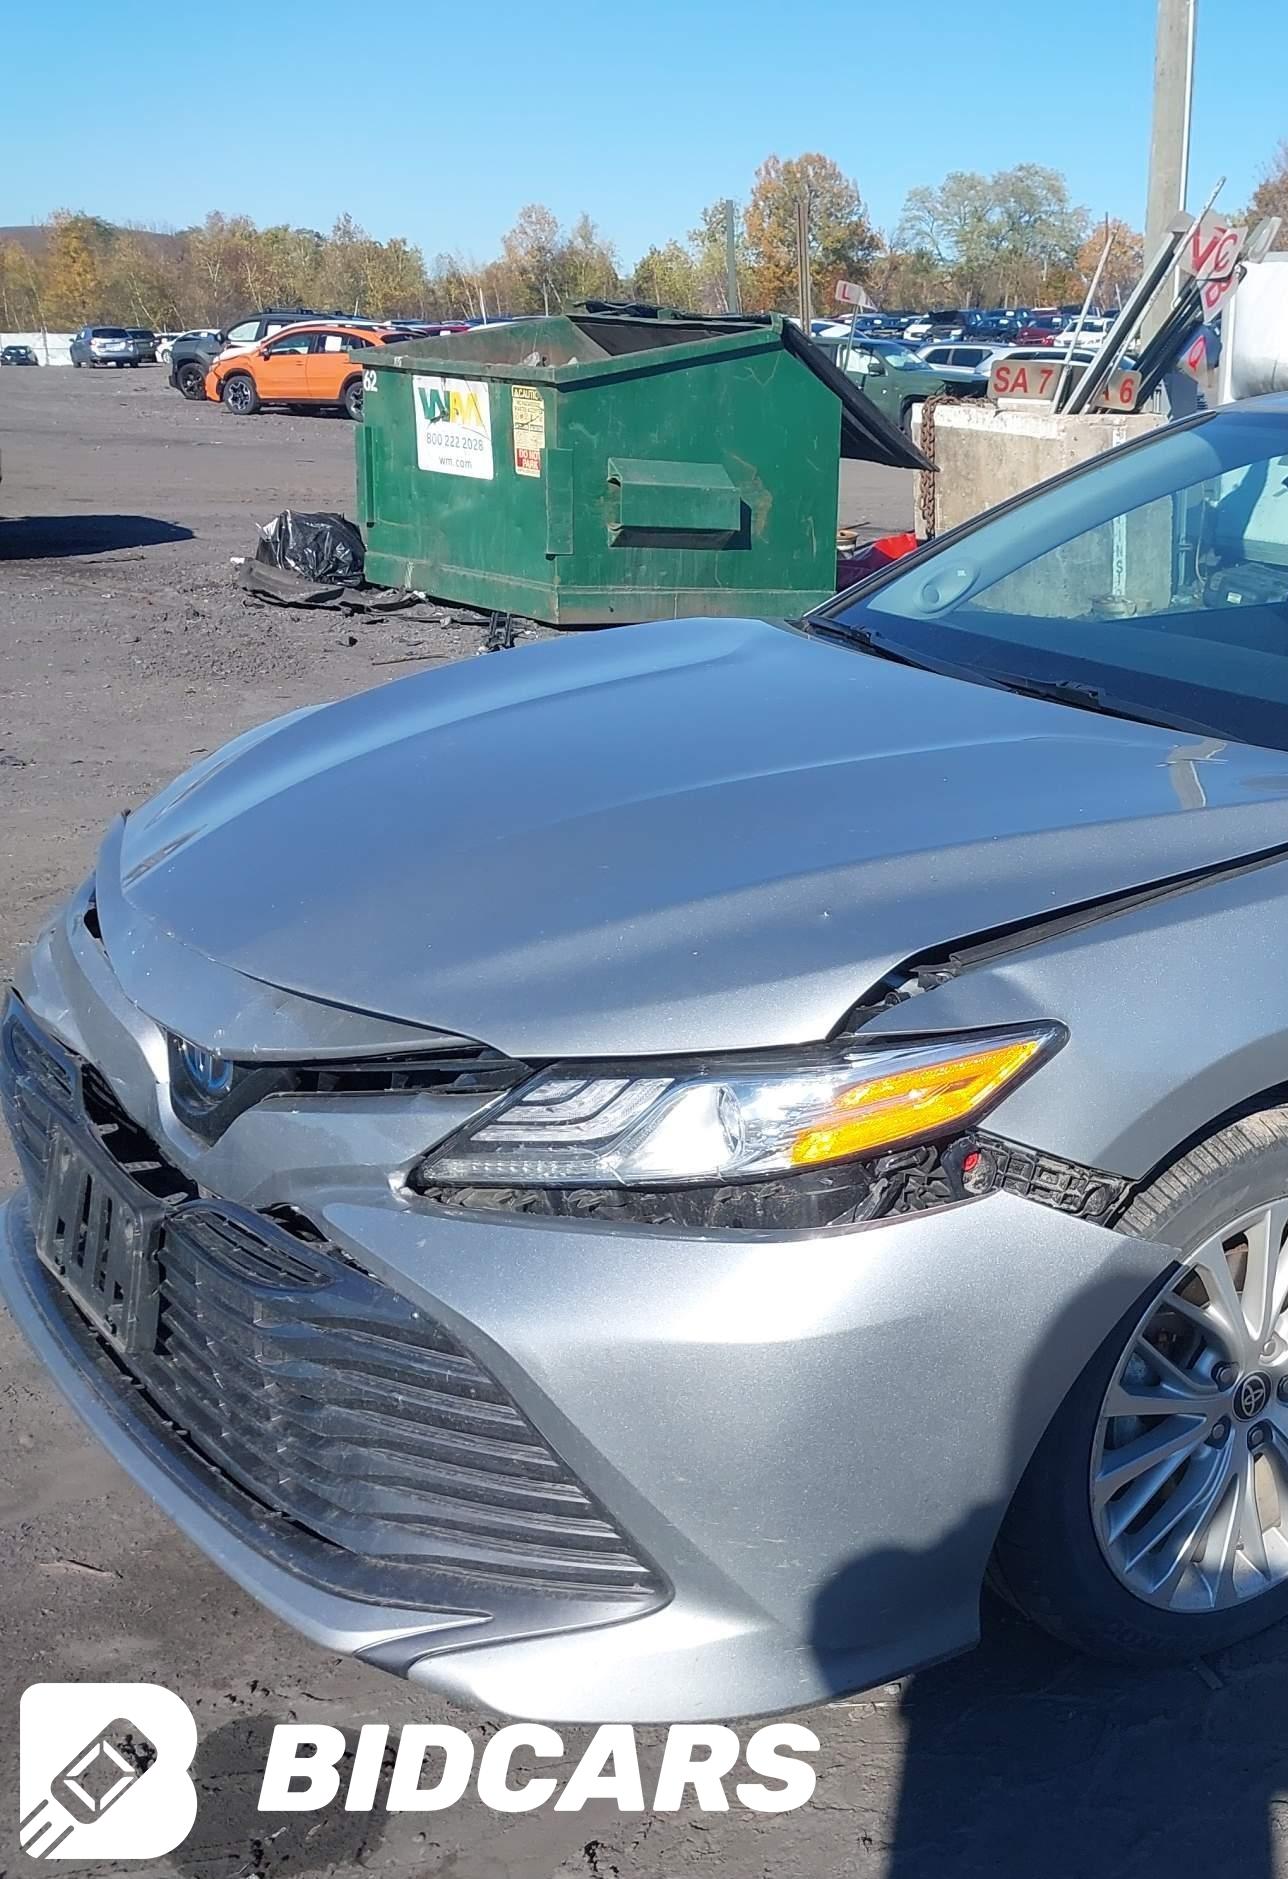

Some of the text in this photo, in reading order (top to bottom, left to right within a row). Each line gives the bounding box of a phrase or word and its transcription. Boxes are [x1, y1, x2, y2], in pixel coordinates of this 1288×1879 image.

[363, 370, 378, 392] 62
[993, 366, 1054, 394] SA 7
[1119, 378, 1134, 404] 6
[418, 387, 484, 427] WM
[426, 432, 484, 452] 800 222 2028
[439, 456, 472, 470] wm.com
[518, 449, 529, 459] DO
